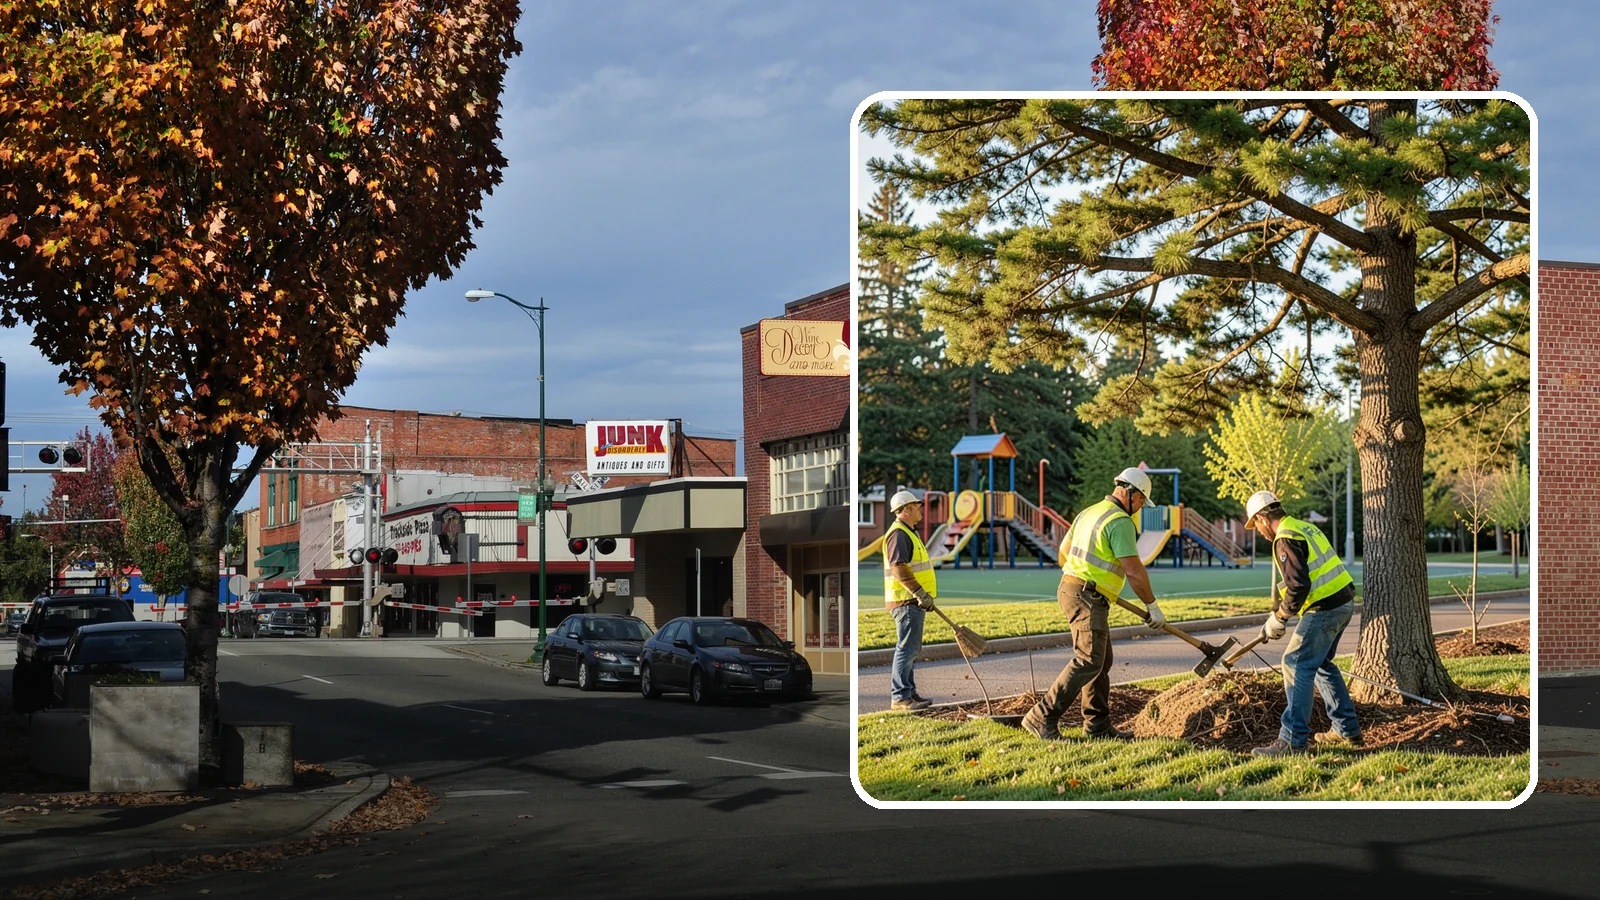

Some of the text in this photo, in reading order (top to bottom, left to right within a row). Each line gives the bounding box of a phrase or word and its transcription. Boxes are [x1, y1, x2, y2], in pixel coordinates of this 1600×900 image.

[595, 425, 665, 457] JUNK
[607, 446, 646, 454] DISORDERLY
[597, 460, 665, 470] ANTIQUES AND GIFTS
[573, 473, 589, 492] RAIL
[390, 520, 429, 540] Trackside Pizza
